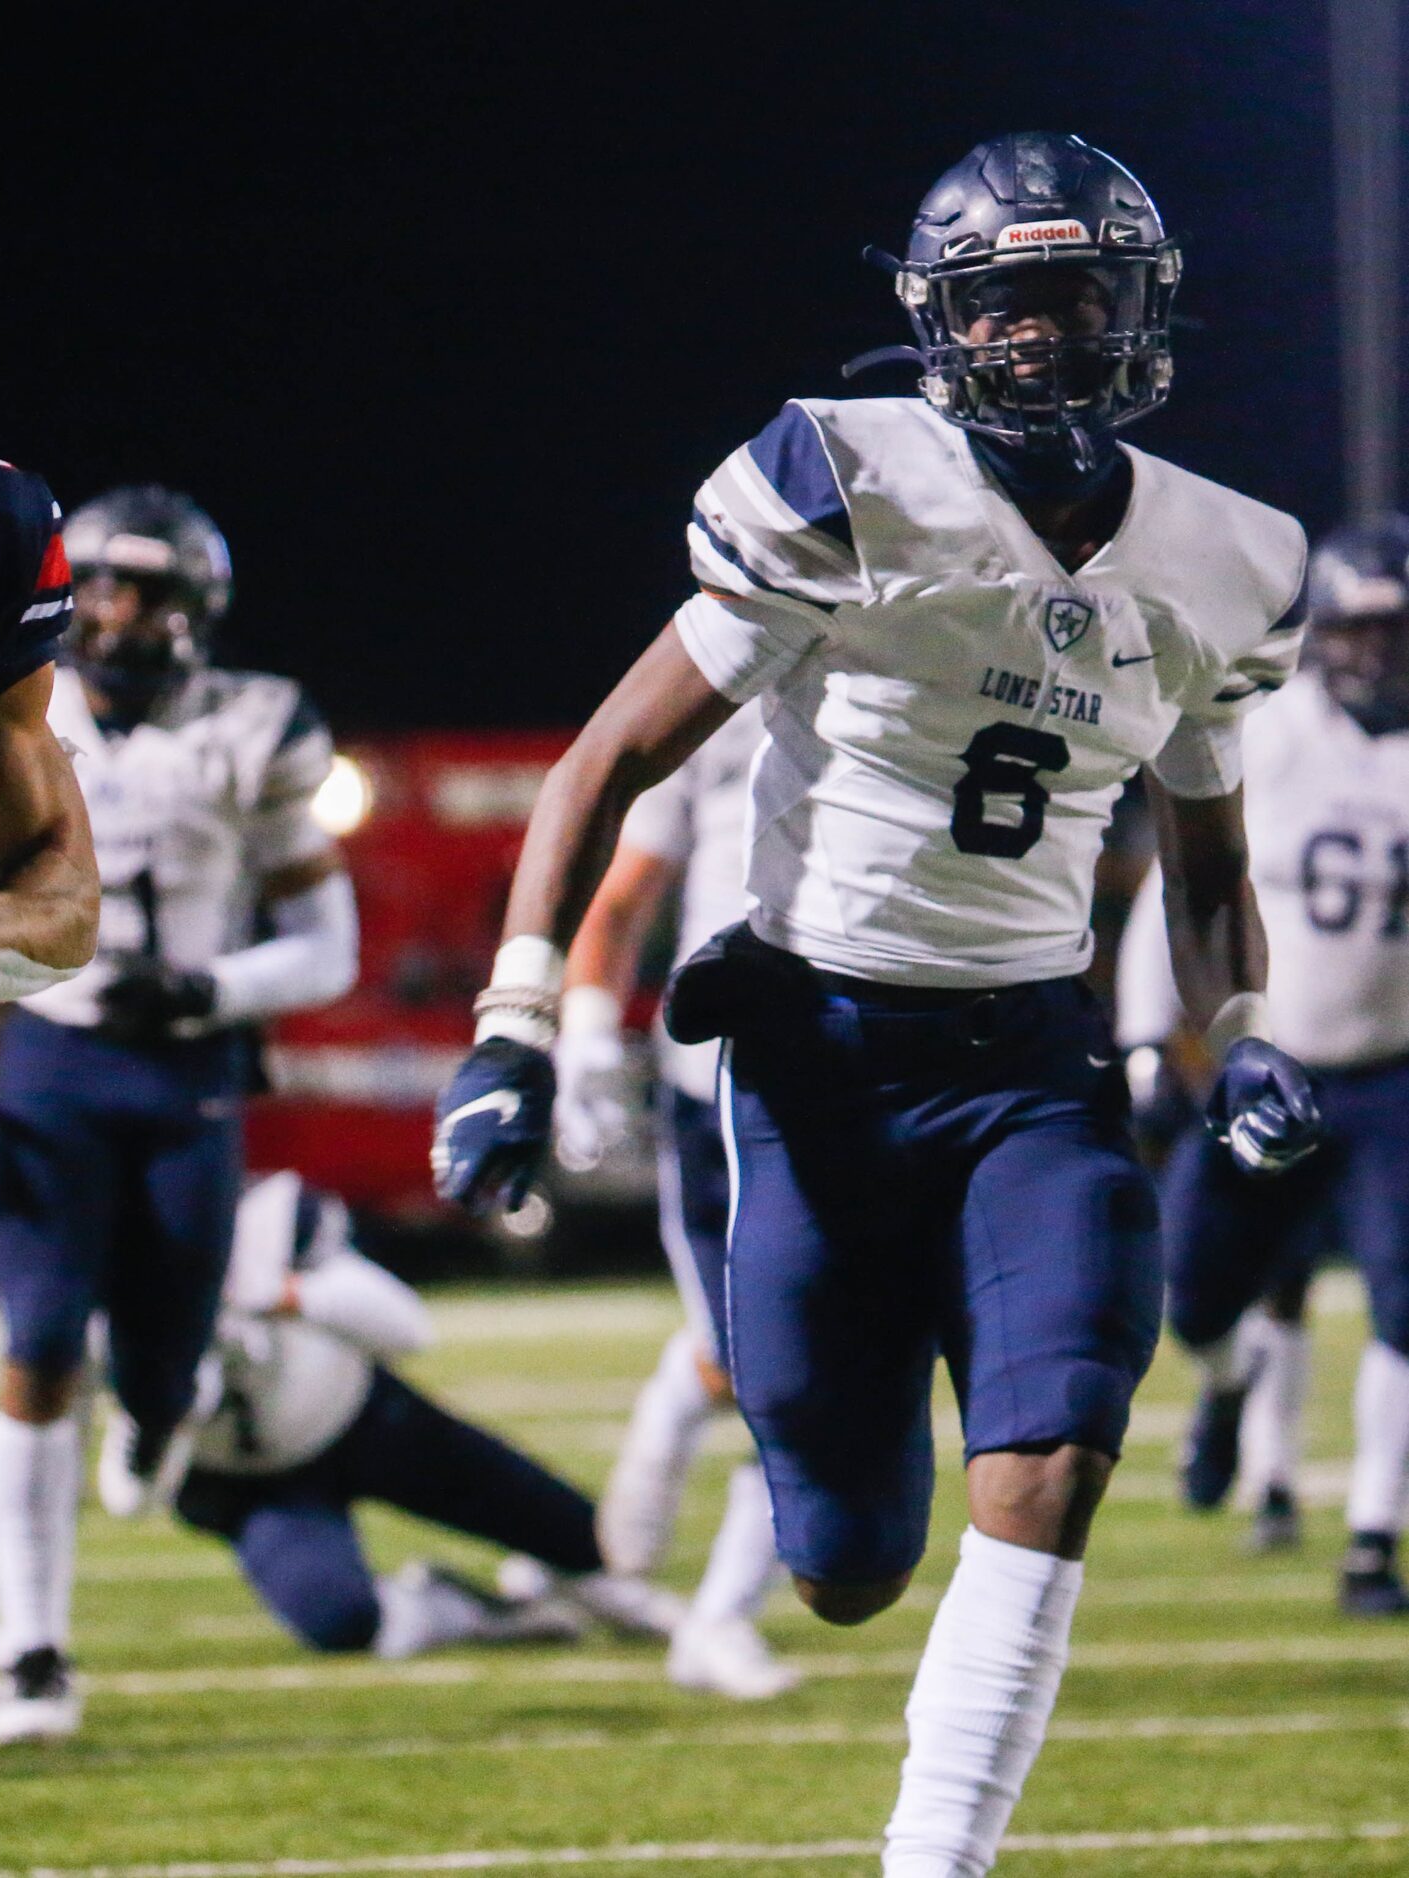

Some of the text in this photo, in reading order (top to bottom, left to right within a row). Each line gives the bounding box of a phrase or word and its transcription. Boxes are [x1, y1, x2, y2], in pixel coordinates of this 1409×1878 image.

[1008, 224, 1081, 243] Riddell
[978, 667, 1103, 725] LONE STAR
[950, 720, 1072, 860] 6
